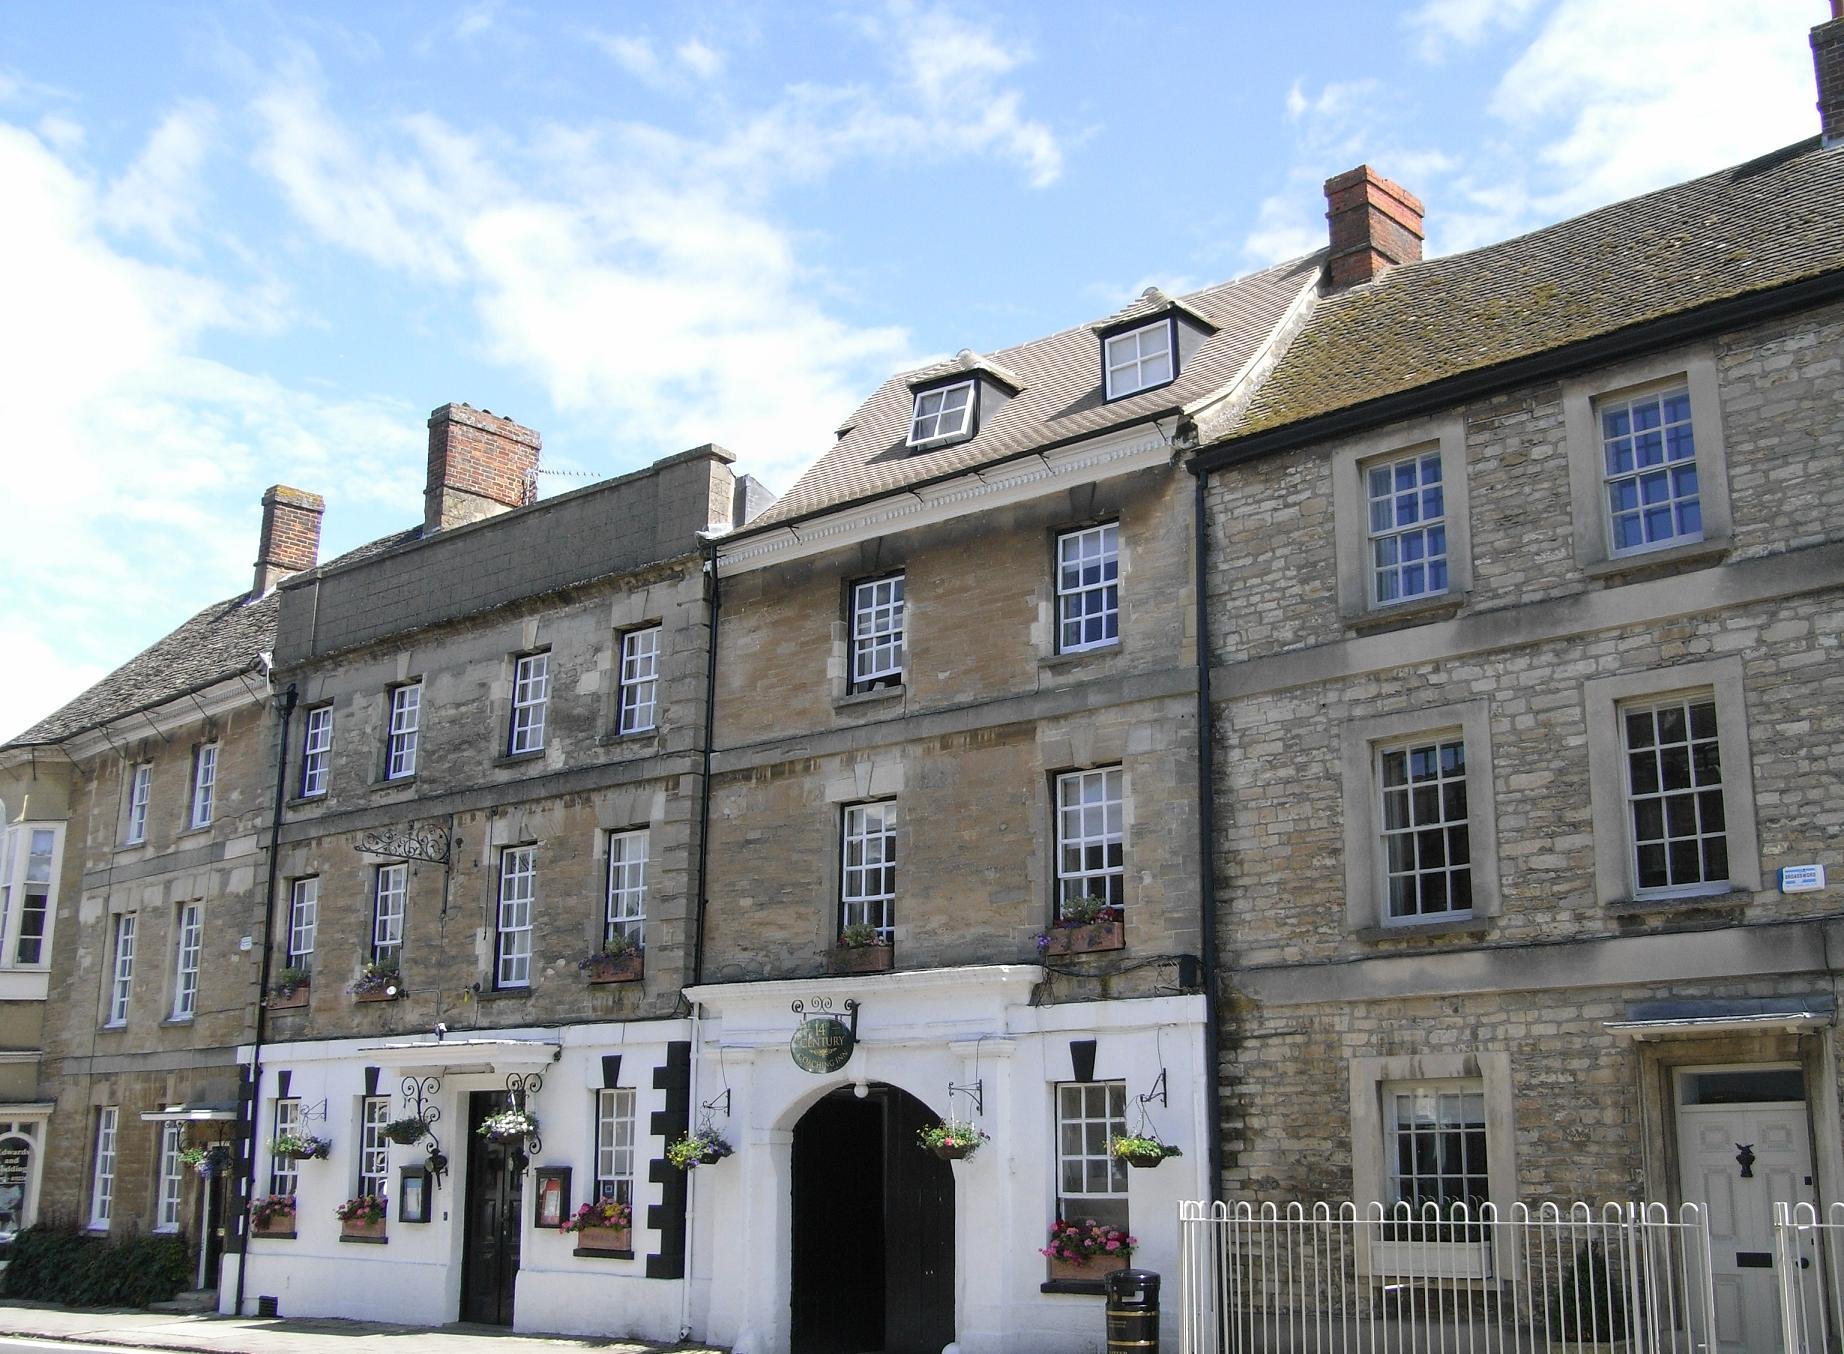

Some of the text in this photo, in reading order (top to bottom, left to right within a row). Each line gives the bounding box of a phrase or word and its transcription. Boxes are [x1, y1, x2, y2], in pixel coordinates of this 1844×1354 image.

[800, 1035, 845, 1048] CENTURY
[798, 1050, 848, 1069] COACHING INN
[4, 1156, 20, 1164] and
